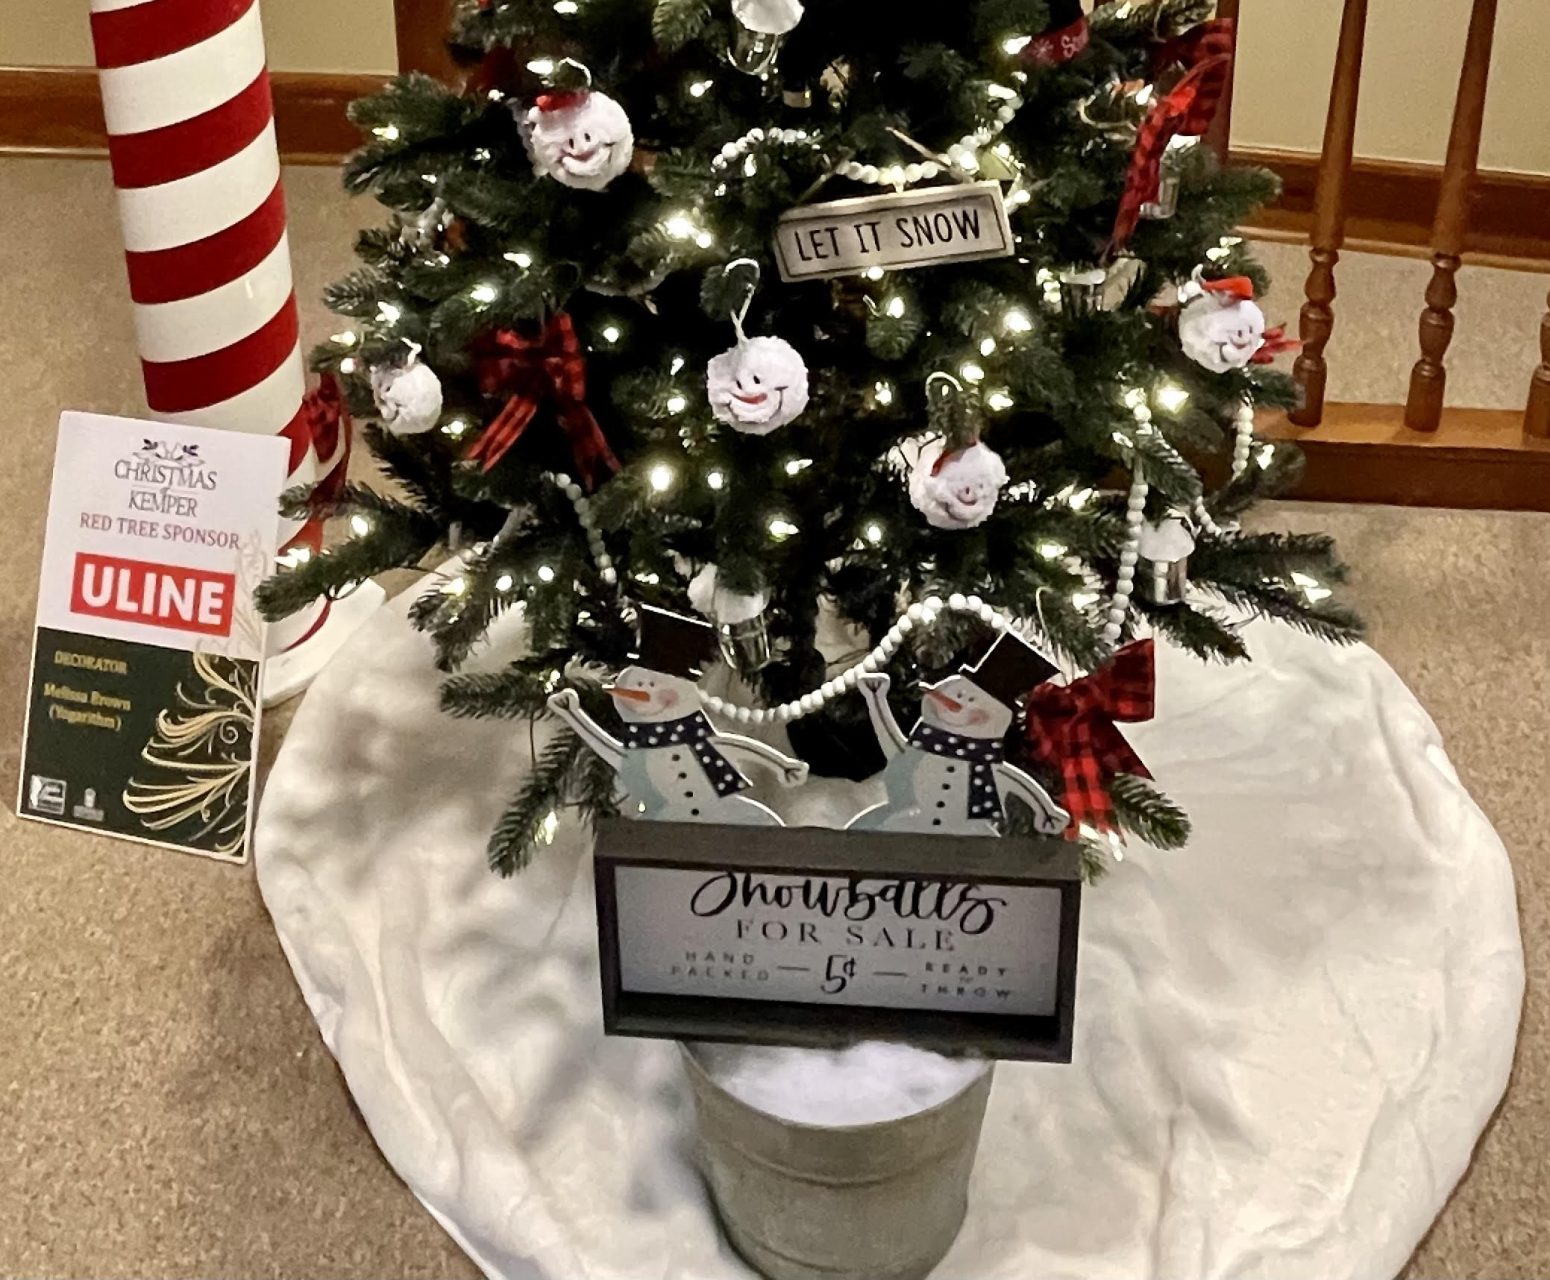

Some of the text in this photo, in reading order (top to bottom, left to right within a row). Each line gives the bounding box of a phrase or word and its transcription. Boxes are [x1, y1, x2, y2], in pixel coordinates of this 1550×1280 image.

[794, 209, 980, 261] LET IT SNOW
[114, 459, 217, 490] CHRISTMAS
[128, 490, 198, 517] KEMPER
[80, 512, 240, 549] RED TREE SPONSOR
[82, 563, 225, 625] ULINE
[737, 919, 956, 951] FOR SALE
